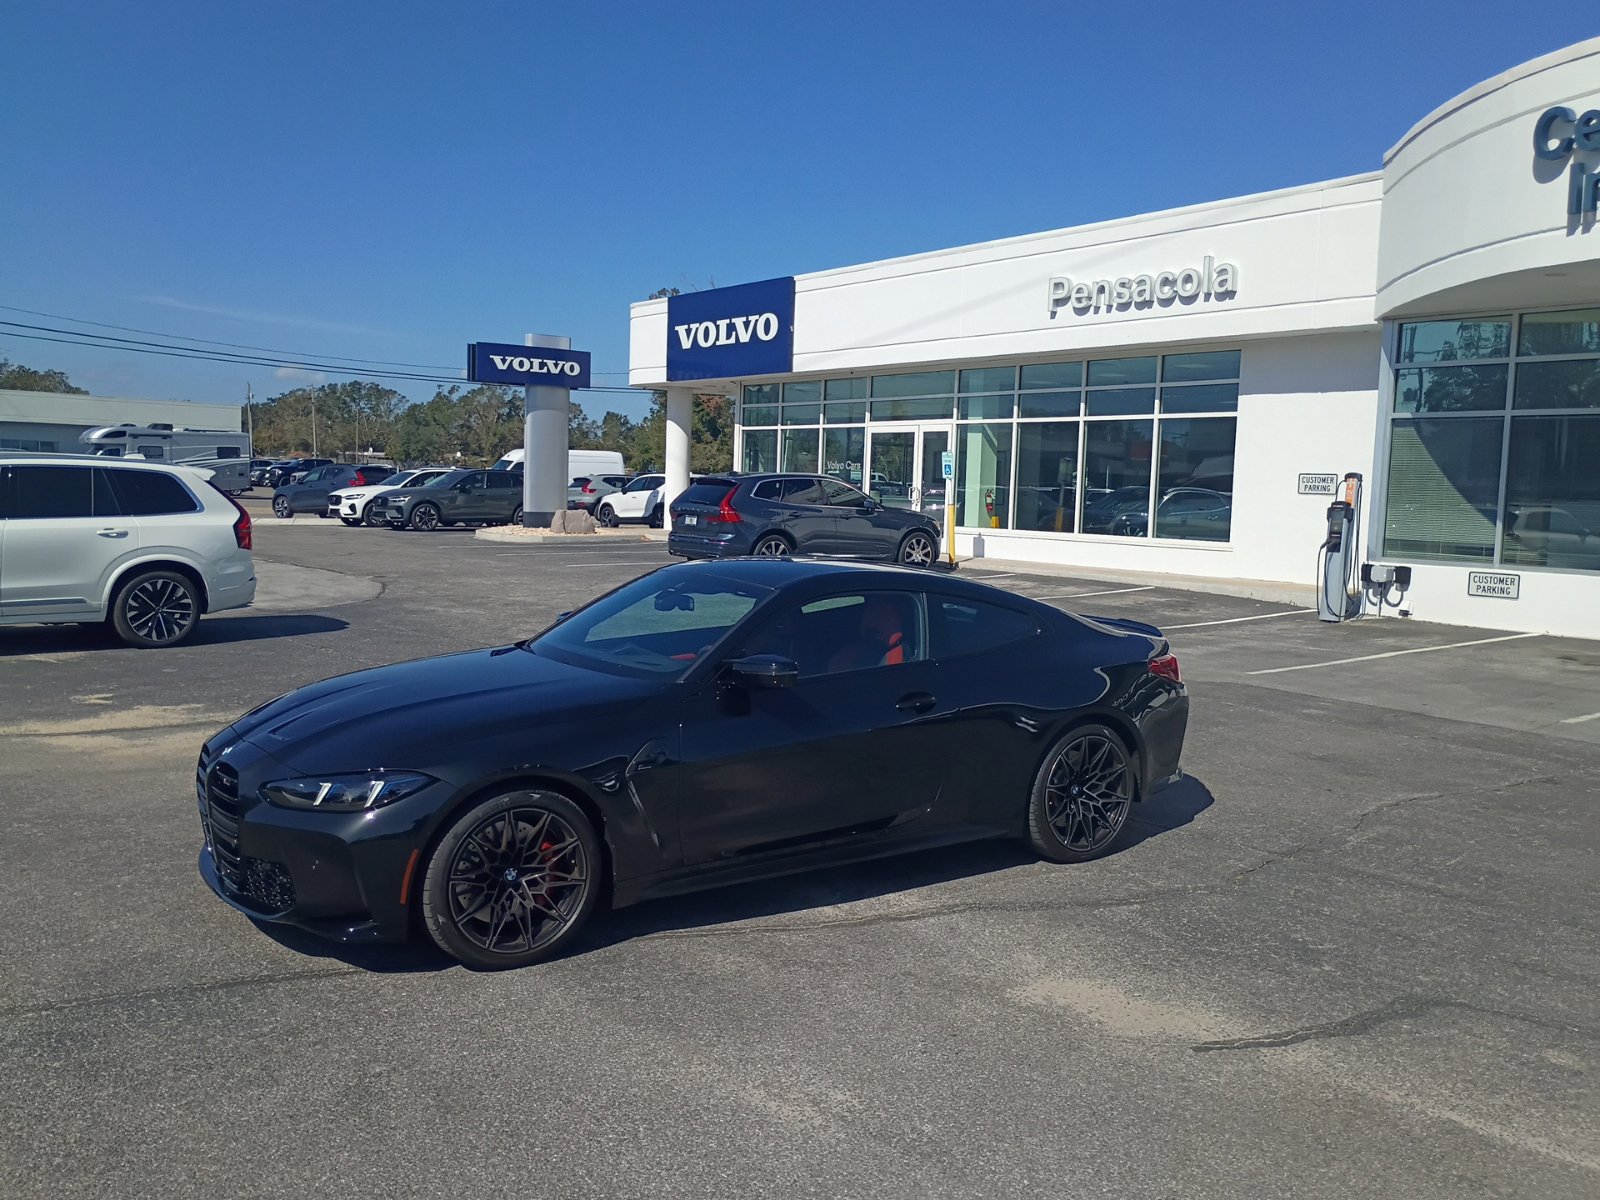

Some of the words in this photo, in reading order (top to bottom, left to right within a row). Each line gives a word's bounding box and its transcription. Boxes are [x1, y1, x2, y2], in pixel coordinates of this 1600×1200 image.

[1048, 255, 1238, 313] Pensacola
[674, 312, 779, 350] VOLVO
[489, 354, 581, 376] VOLVO
[826, 460, 845, 470] Volvo
[845, 460, 861, 470] Cars
[1301, 476, 1335, 484] CUSTOMER
[1304, 484, 1331, 492] PARKING
[1472, 575, 1516, 586] CUSTOMER
[1476, 584, 1511, 596] PARKING
